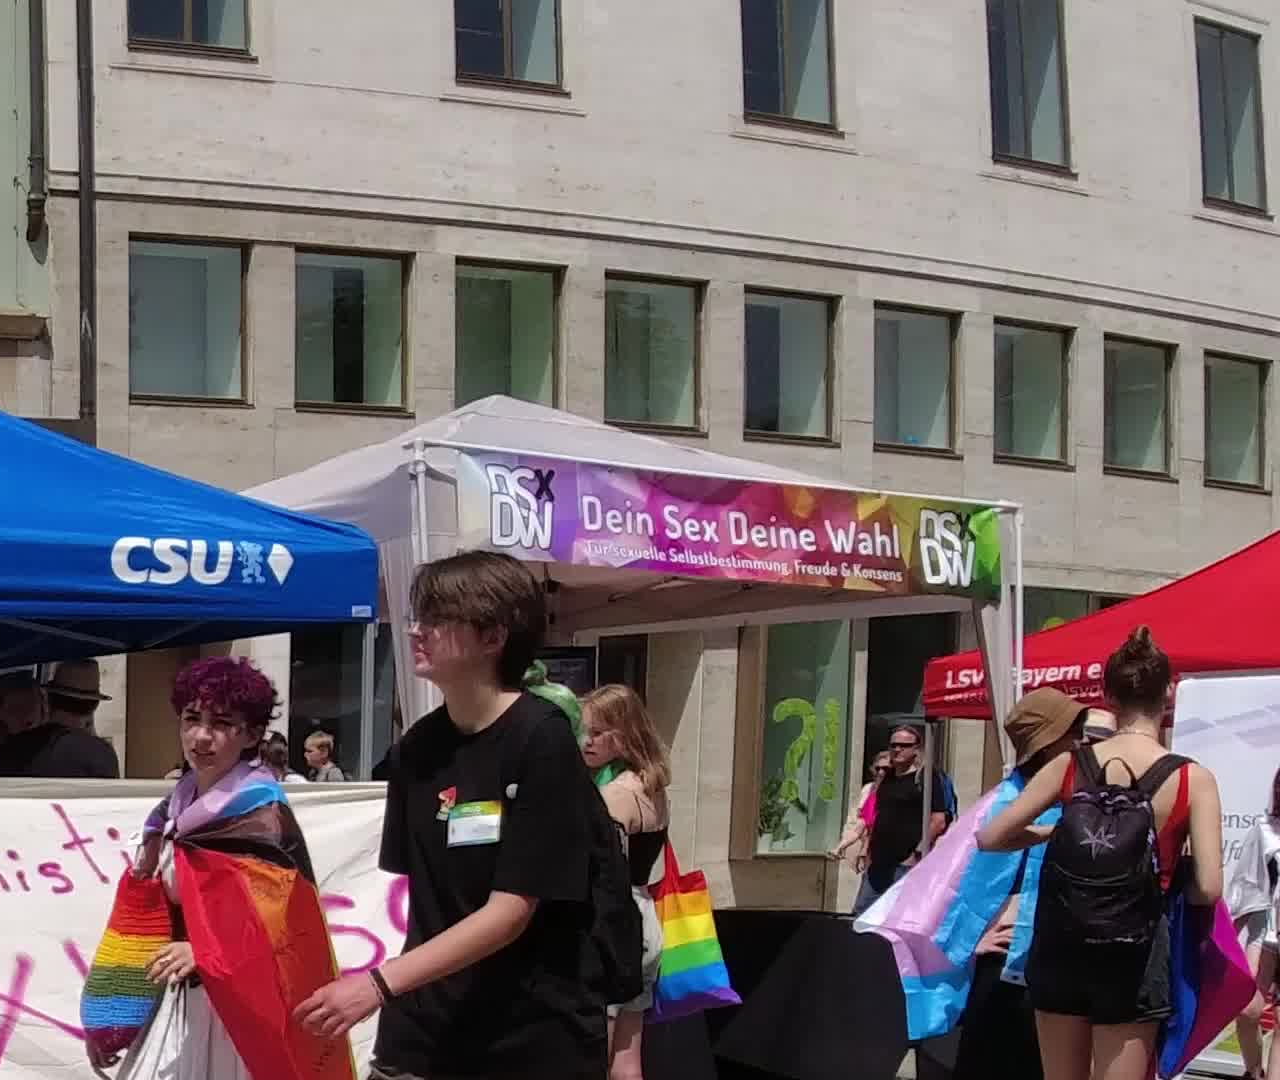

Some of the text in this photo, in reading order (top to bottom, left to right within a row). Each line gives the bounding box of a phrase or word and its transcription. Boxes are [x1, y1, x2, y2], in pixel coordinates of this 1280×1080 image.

[582, 496, 901, 558] Dein Sex Deine Wahl
[110, 536, 234, 585] CSU
[610, 543, 667, 562] sexuelle
[794, 559, 838, 576] Freude
[840, 561, 852, 577] &
[853, 564, 904, 583] Konsens
[945, 669, 985, 689] LSV
